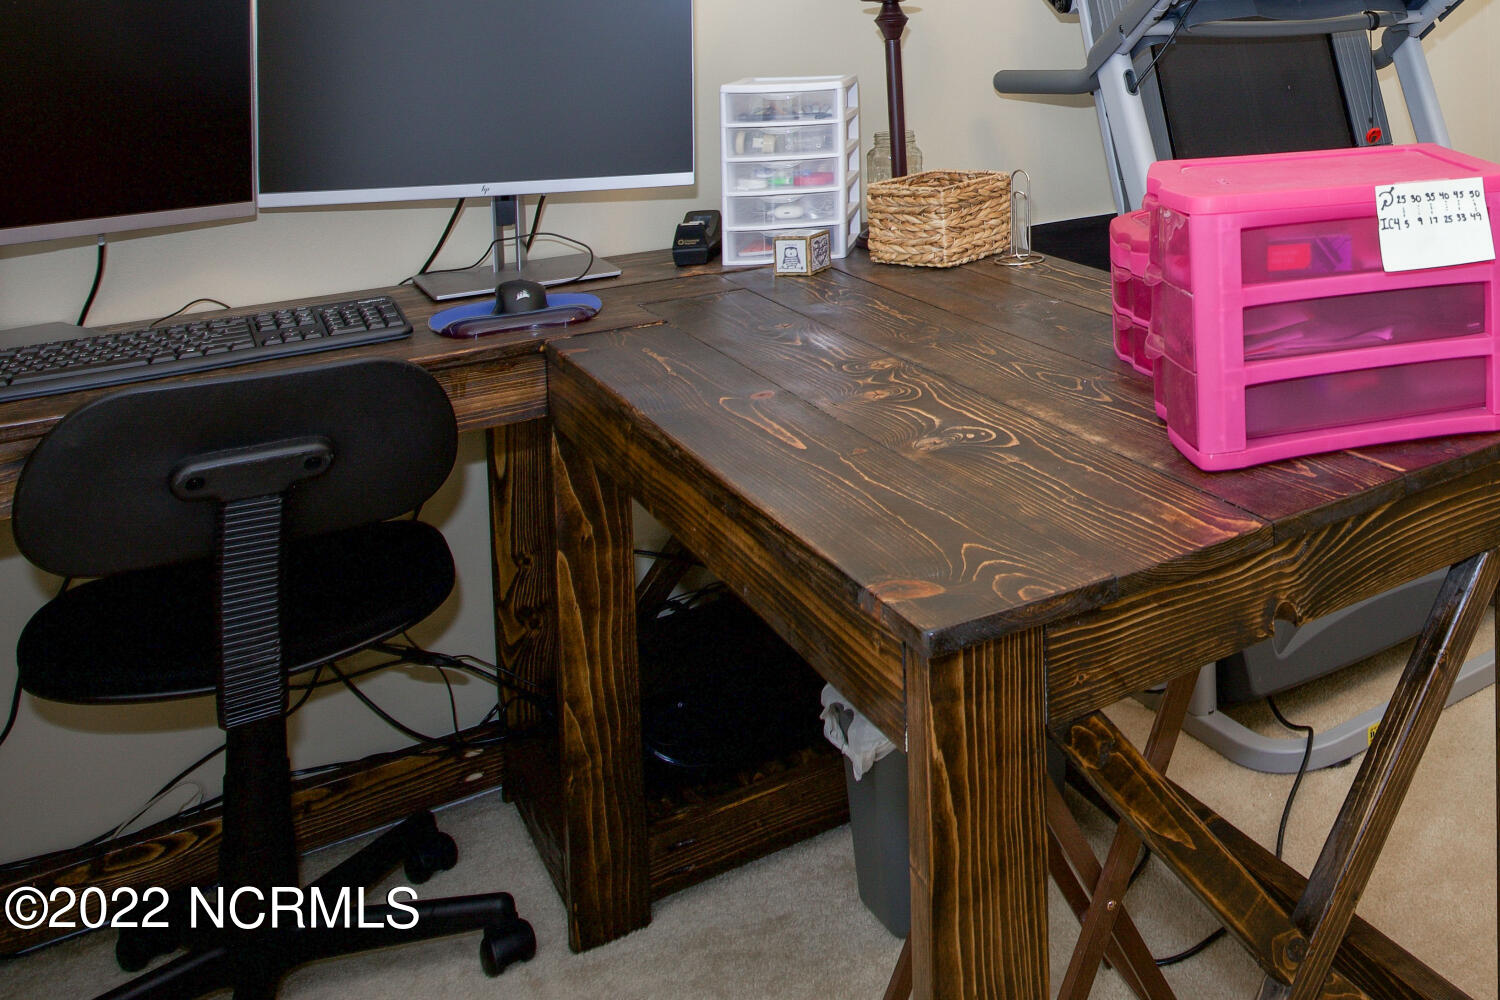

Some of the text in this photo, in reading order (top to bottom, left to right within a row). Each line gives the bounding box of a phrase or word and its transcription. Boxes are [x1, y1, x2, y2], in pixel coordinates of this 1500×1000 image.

[1397, 190, 1480, 204] 25 30 35 40 45 50
[1404, 219, 1410, 229] 5
[1417, 217, 1423, 226] 9
[1430, 216, 1439, 224] 17
[1444, 215, 1453, 223] 25
[1457, 214, 1467, 222] 33
[1470, 212, 1482, 220] 49
